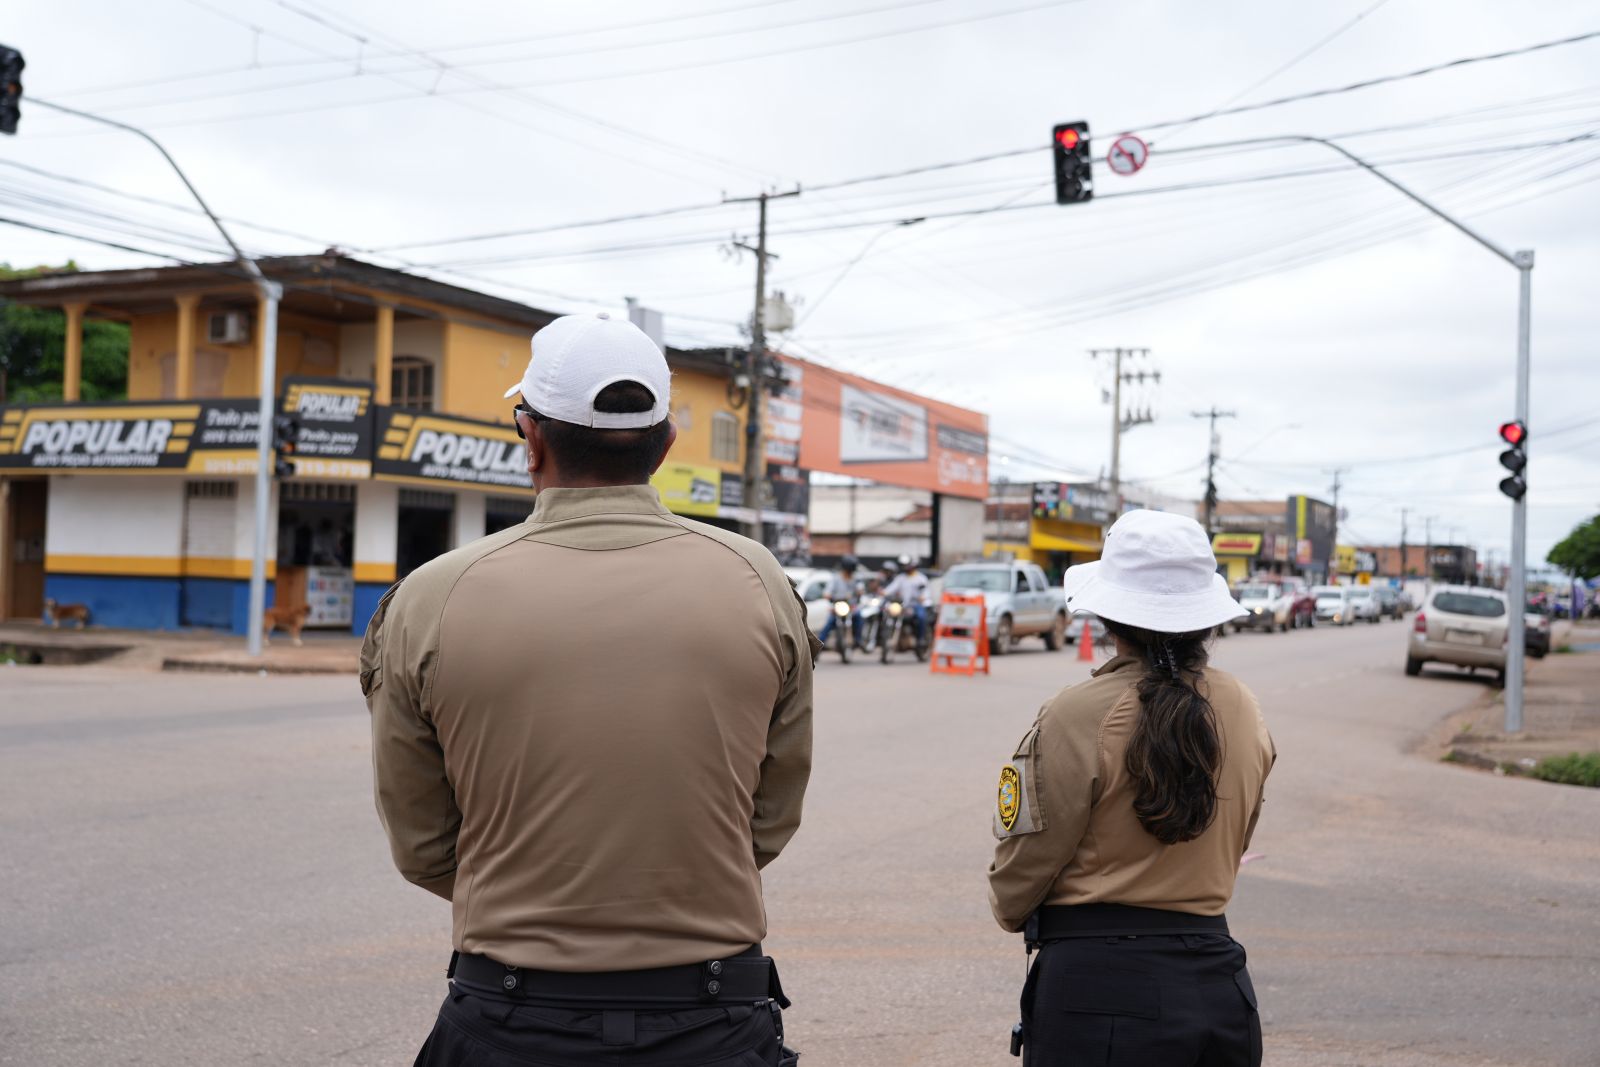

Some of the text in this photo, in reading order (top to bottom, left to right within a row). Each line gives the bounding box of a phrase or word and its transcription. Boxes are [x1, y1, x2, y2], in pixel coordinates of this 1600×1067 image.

[299, 392, 360, 414] POPULAR
[22, 420, 172, 454] POPULAR
[411, 430, 528, 473] POPULA
